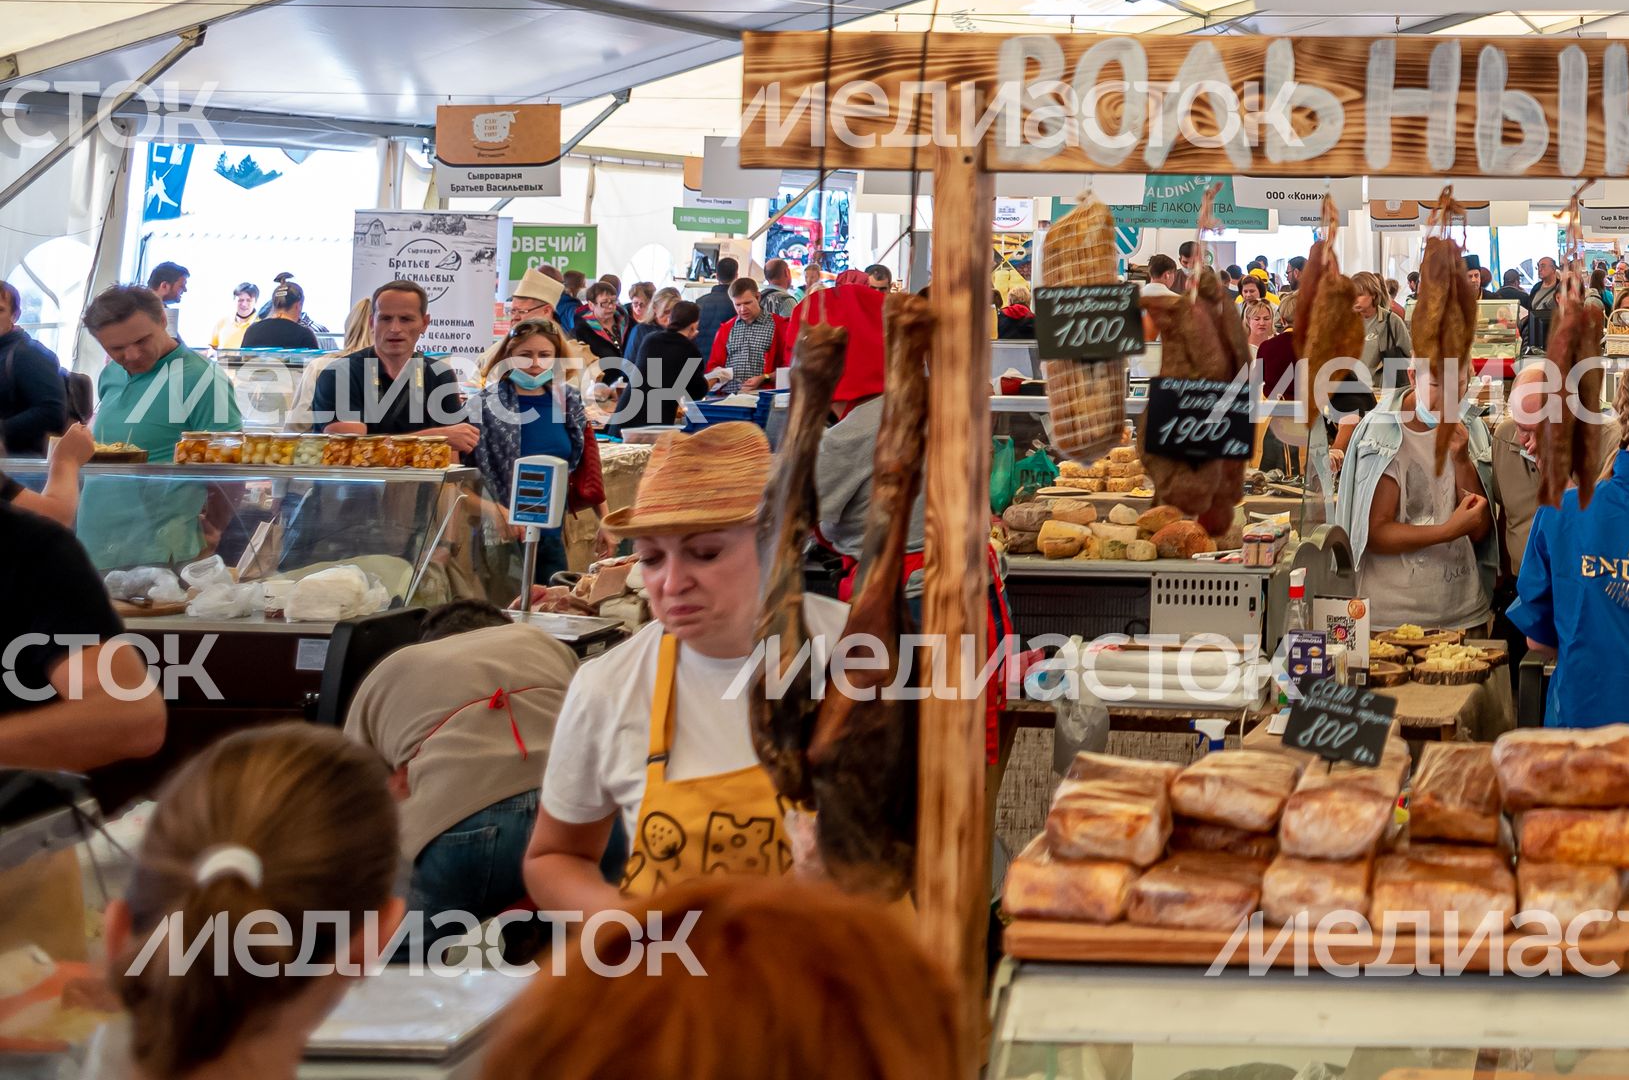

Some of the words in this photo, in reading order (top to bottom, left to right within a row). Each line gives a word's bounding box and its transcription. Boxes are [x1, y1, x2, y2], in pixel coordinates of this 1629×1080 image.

[450, 184, 484, 193] Братьев
[1146, 181, 1194, 199] ALDINI
[1266, 192, 1285, 200] ООО
[1160, 202, 1234, 213] ЛАКОМТВА
[511, 233, 586, 252] ОВЕЧИЙ
[1159, 416, 1232, 446] 1900
[1298, 713, 1359, 749] 800
